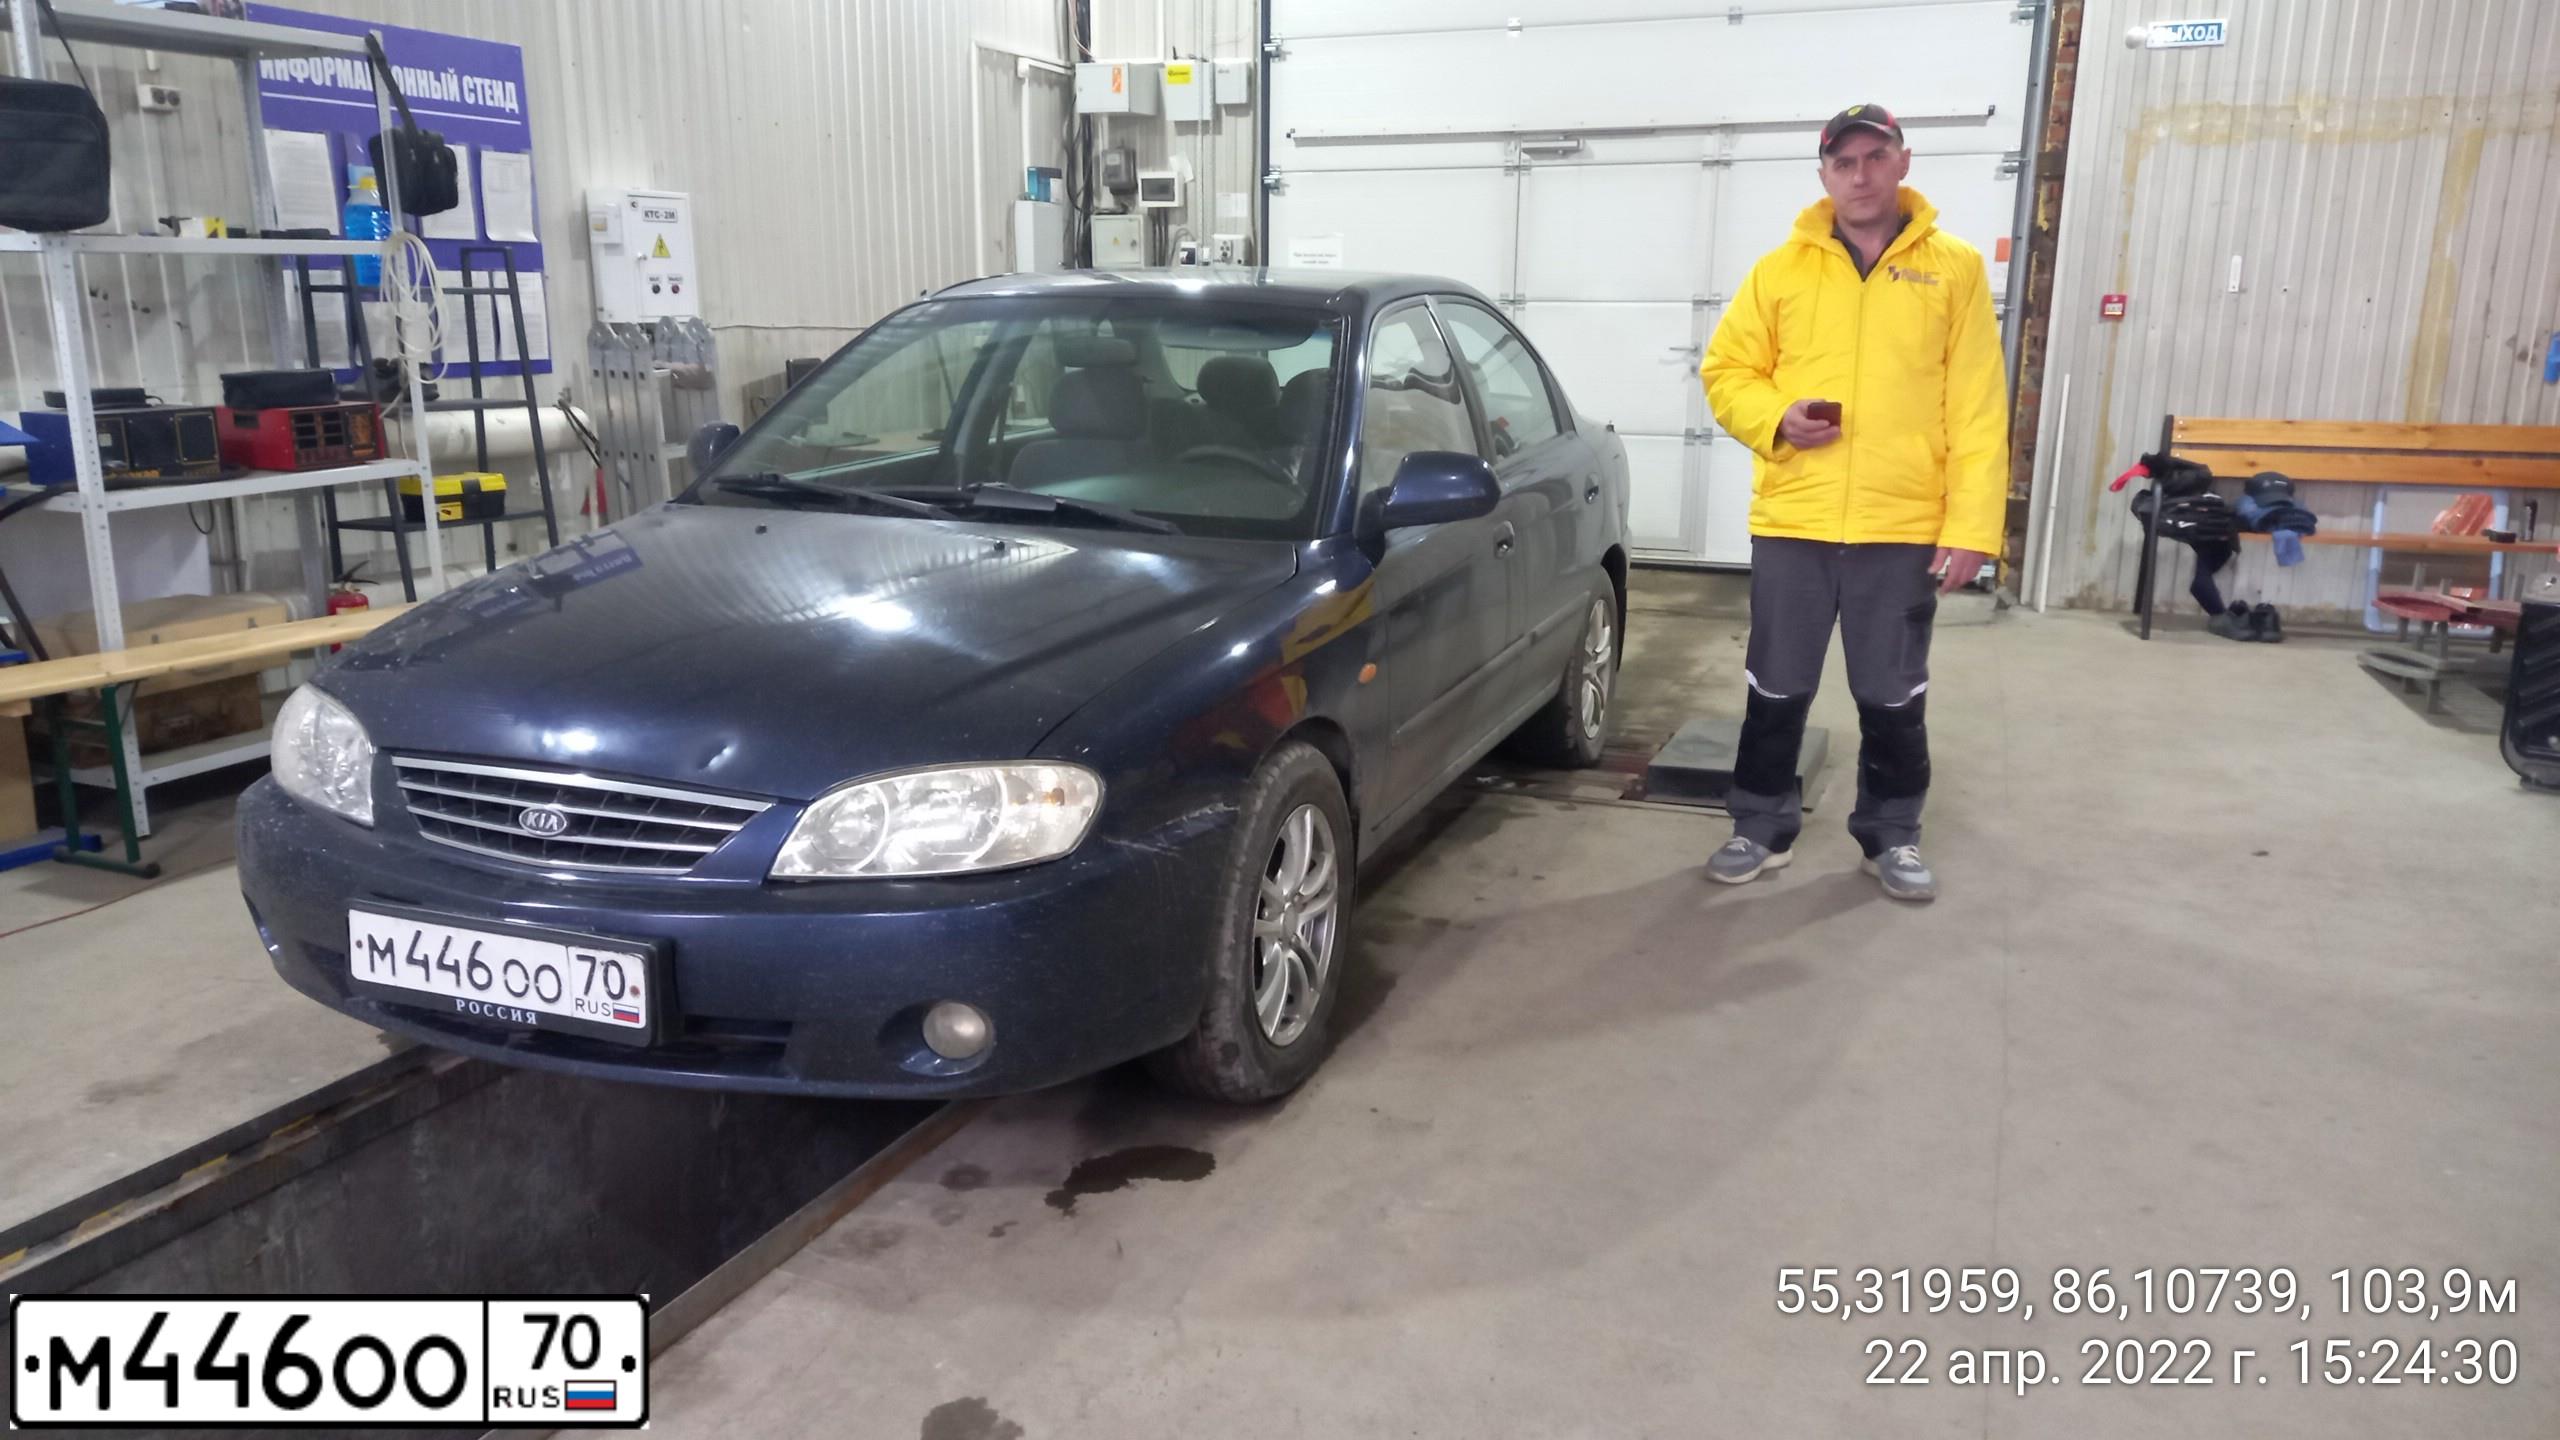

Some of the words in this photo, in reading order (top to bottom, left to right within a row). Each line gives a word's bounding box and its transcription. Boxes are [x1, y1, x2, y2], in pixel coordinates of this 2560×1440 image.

[462, 75, 519, 114] СТЕНД
[526, 811, 558, 831] KIA
[576, 953, 627, 1001] 70
[455, 999, 538, 1026] РОССИЯ
[574, 997, 612, 1018] RUS
